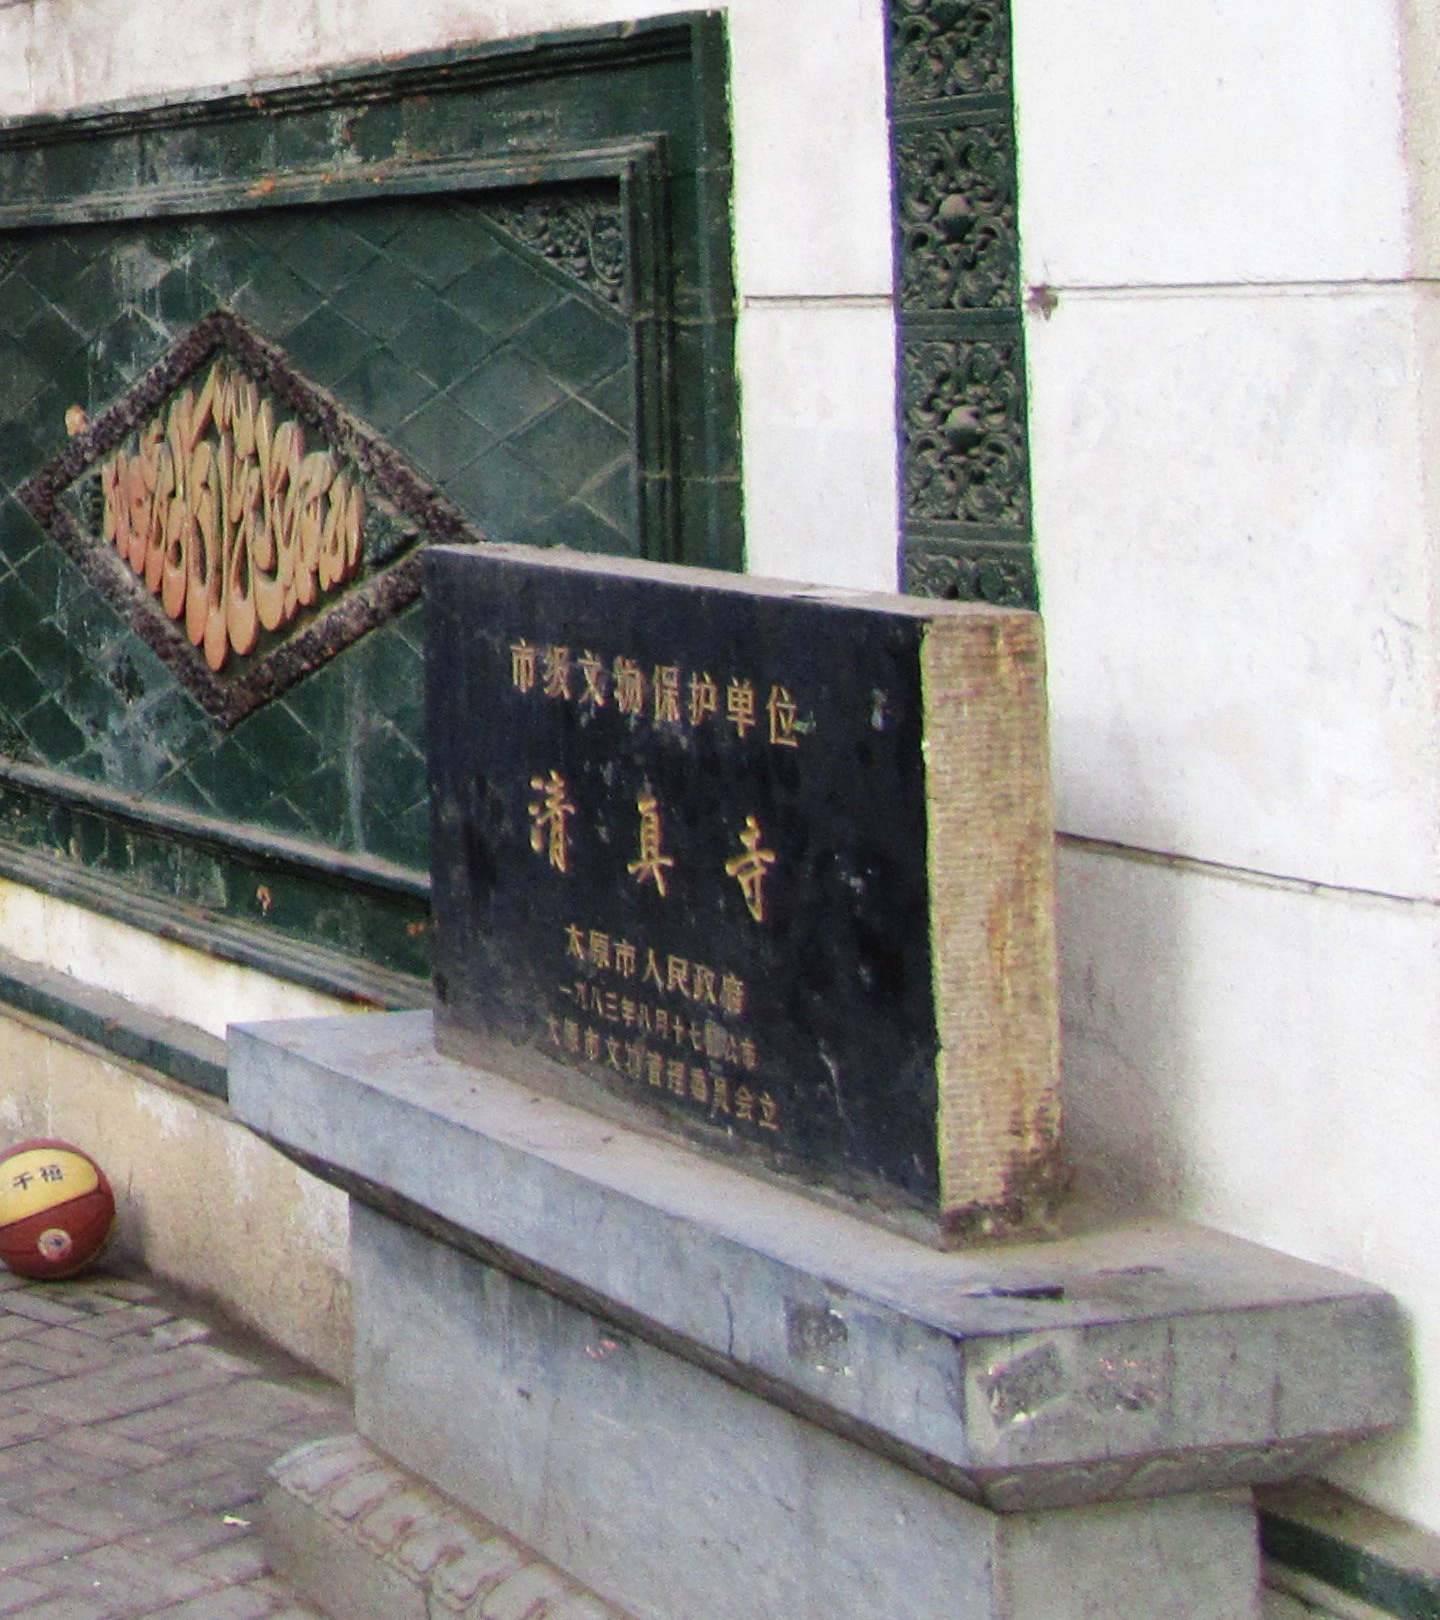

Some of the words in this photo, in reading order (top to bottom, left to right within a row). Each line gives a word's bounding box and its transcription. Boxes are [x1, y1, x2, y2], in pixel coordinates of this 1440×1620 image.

[510, 637, 799, 748] 市级文物保护单位
[528, 769, 776, 924] 清真寺
[564, 923, 746, 1016] 太原市人民政府
